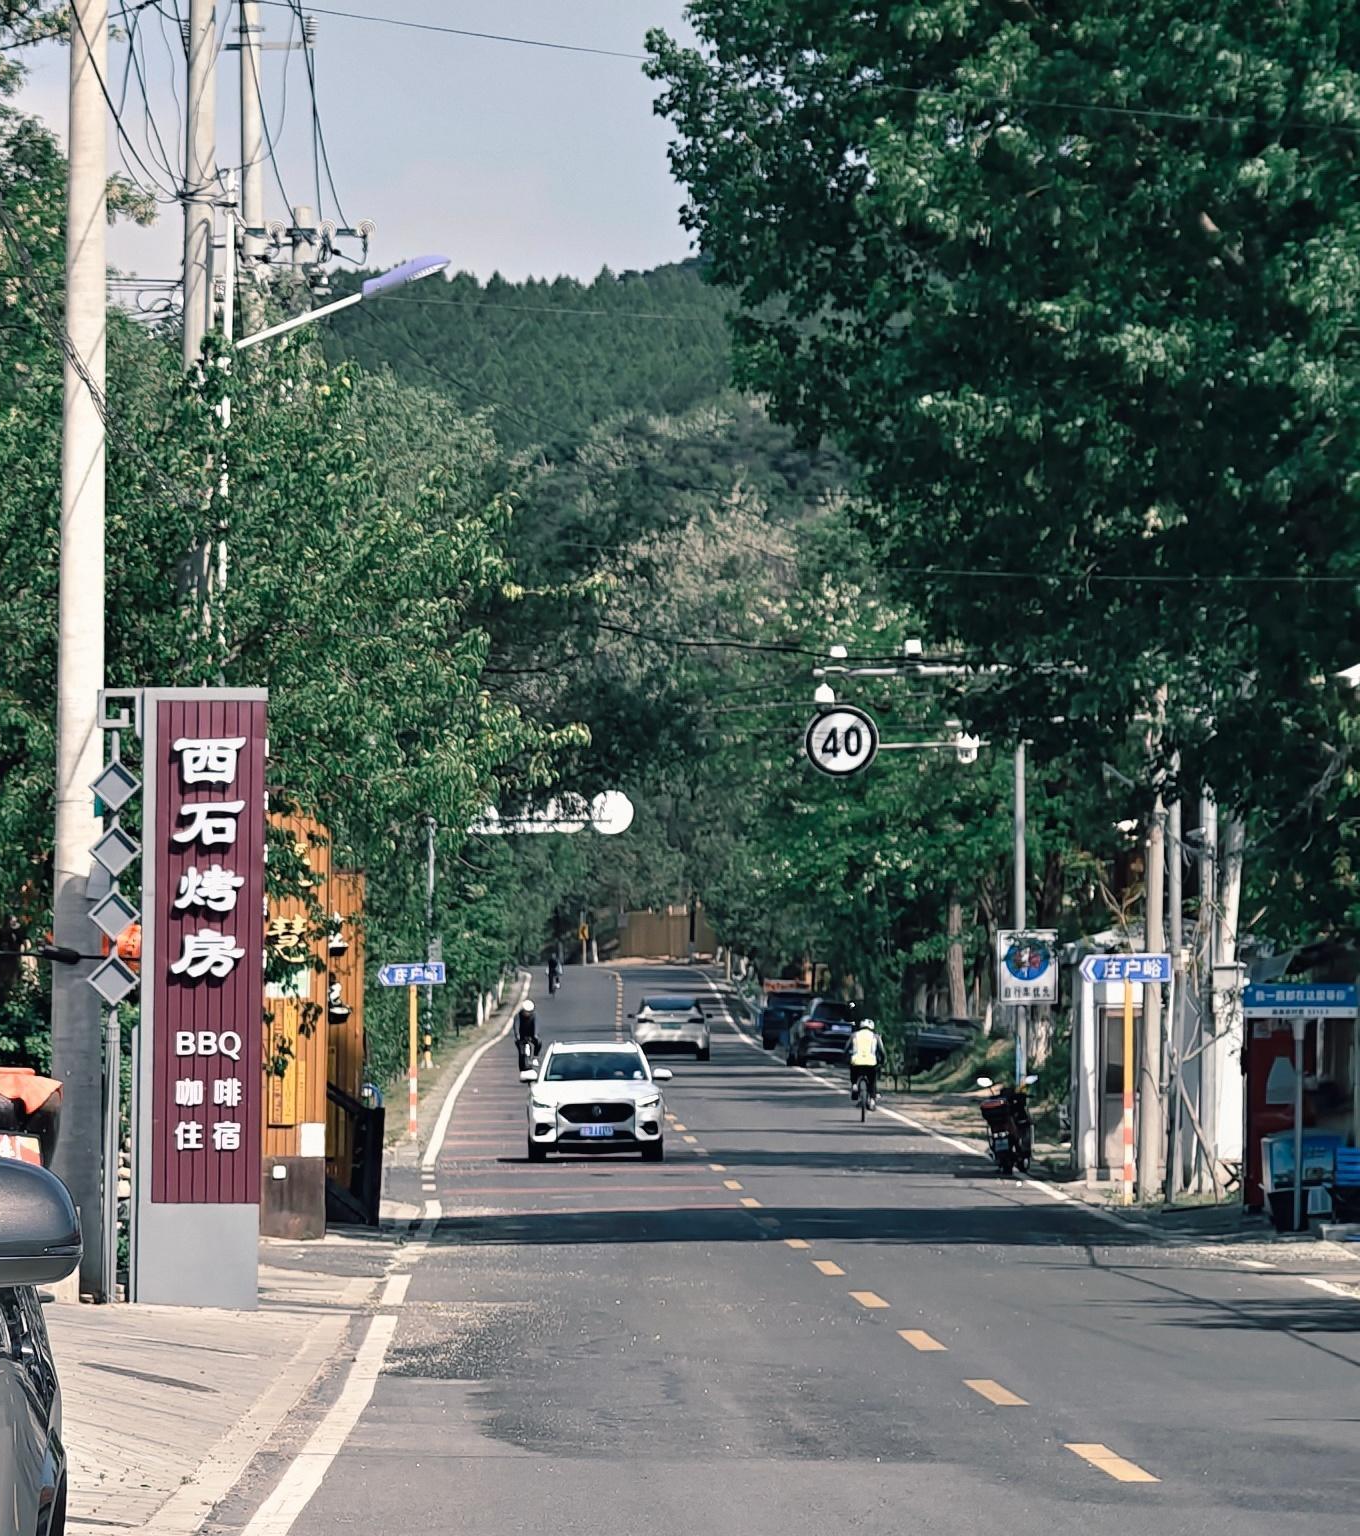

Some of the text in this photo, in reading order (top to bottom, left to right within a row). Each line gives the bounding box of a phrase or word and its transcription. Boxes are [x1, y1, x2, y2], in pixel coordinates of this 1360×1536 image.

[821, 726, 862, 758] 40
[171, 737, 247, 978] 西石烤房
[1103, 958, 1162, 978] 庄户峪
[176, 1031, 242, 1061] BBQ
[175, 1078, 242, 1107] 咖啡
[174, 1120, 241, 1151] 住宿
